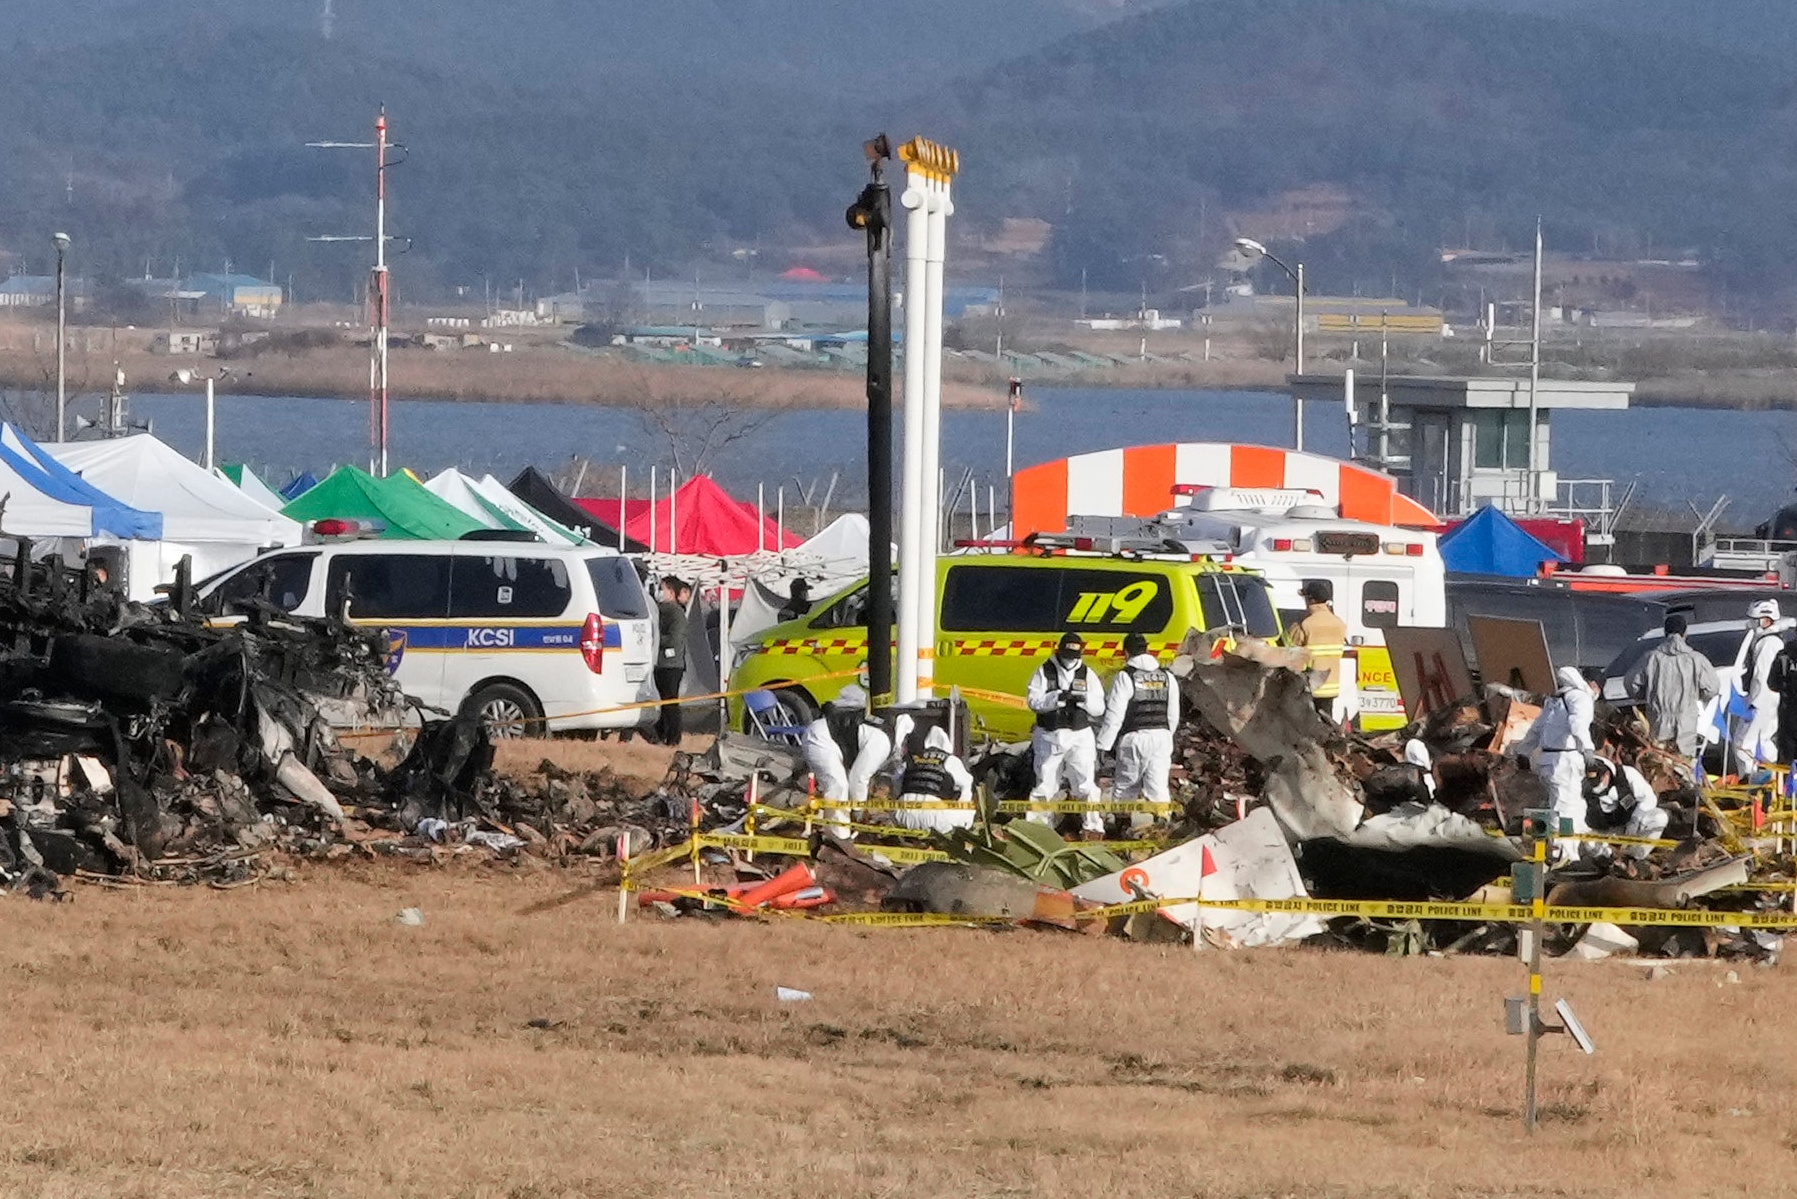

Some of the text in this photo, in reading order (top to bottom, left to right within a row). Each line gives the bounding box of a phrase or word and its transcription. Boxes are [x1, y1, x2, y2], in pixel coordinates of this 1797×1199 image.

[1066, 581, 1158, 623] 119
[468, 628, 514, 646] KCSI
[1306, 903, 1338, 913] POLICE
[1341, 904, 1360, 913] LINE
[1428, 905, 1459, 916] POLICE
[1462, 906, 1482, 917] LINE
[1549, 908, 1580, 919] POLICE
[1584, 909, 1604, 920] LINE
[1671, 912, 1702, 923] POLICE
[1705, 913, 1726, 923] LINE
